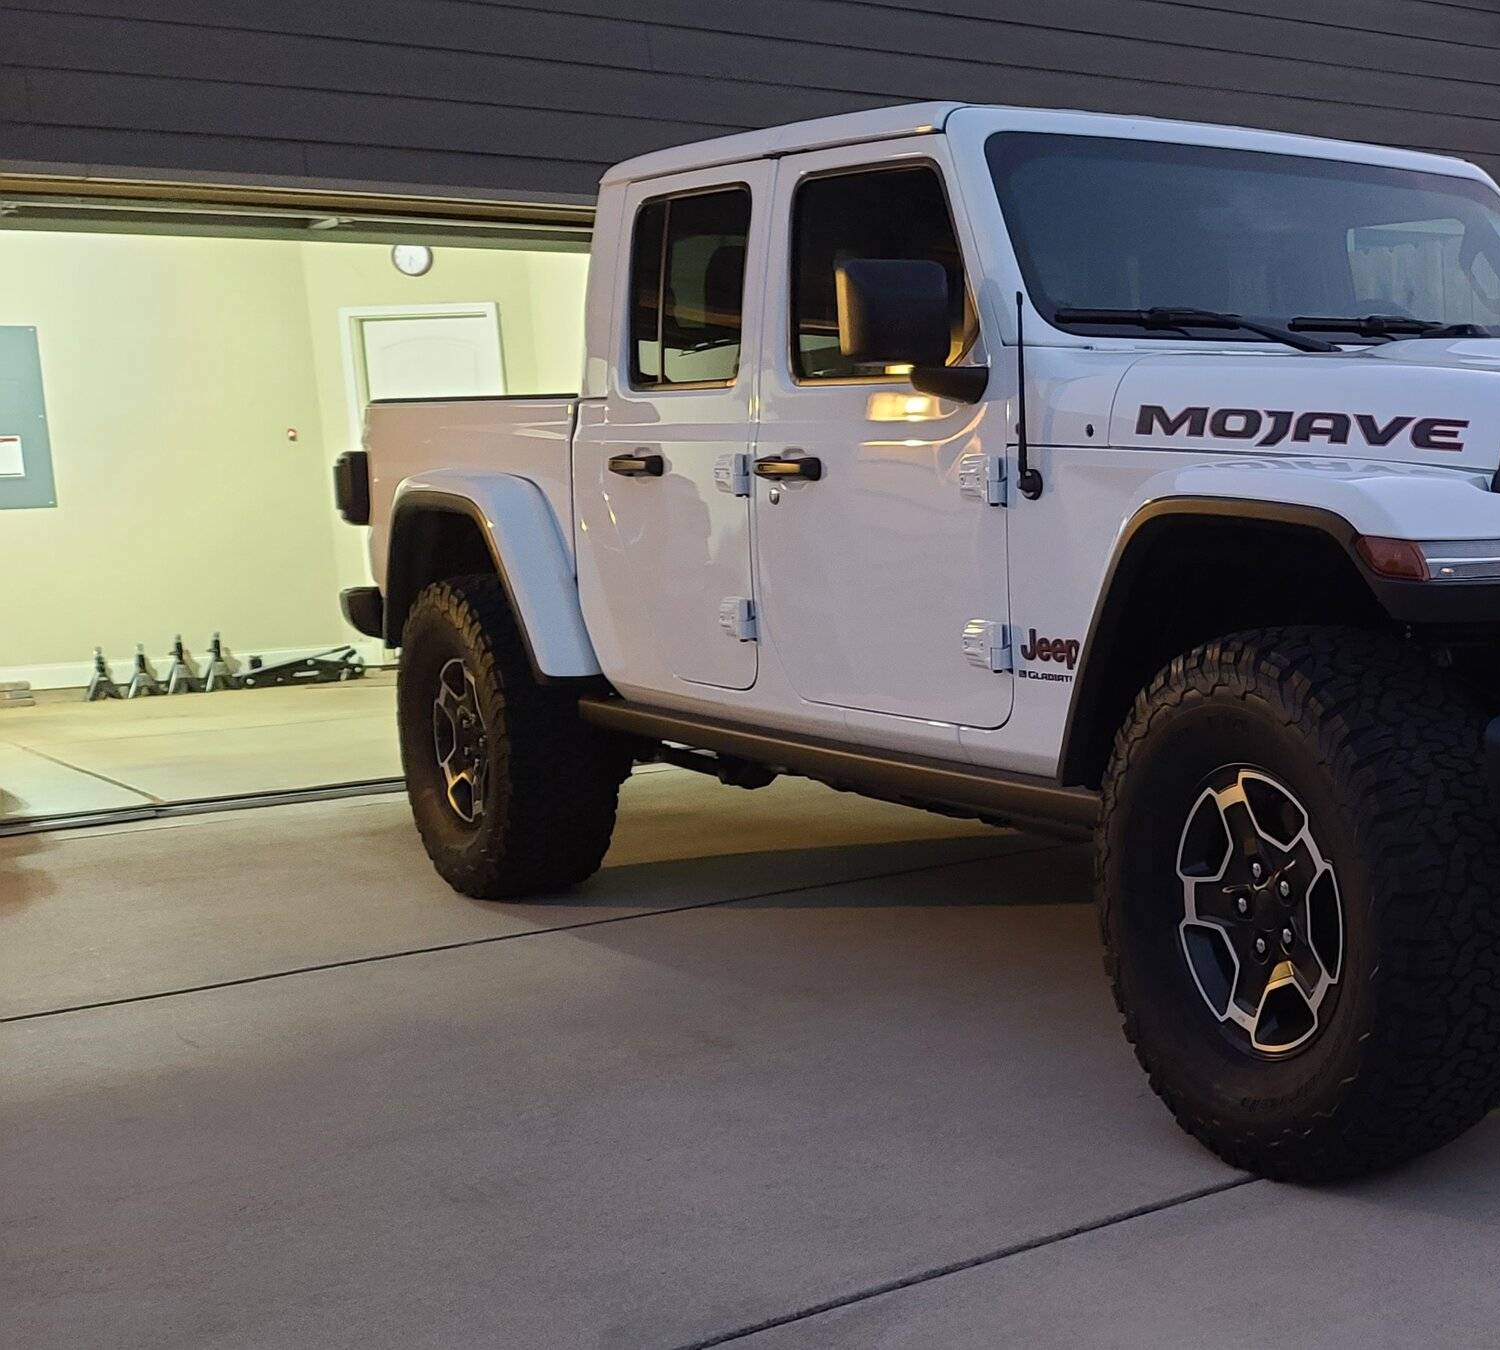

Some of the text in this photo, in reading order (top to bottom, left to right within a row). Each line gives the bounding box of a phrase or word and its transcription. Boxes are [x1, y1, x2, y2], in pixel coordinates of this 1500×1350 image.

[1135, 404, 1470, 452] MOJAVE
[1020, 628, 1080, 670] Jeep
[1028, 671, 1073, 683] GLADIAT
